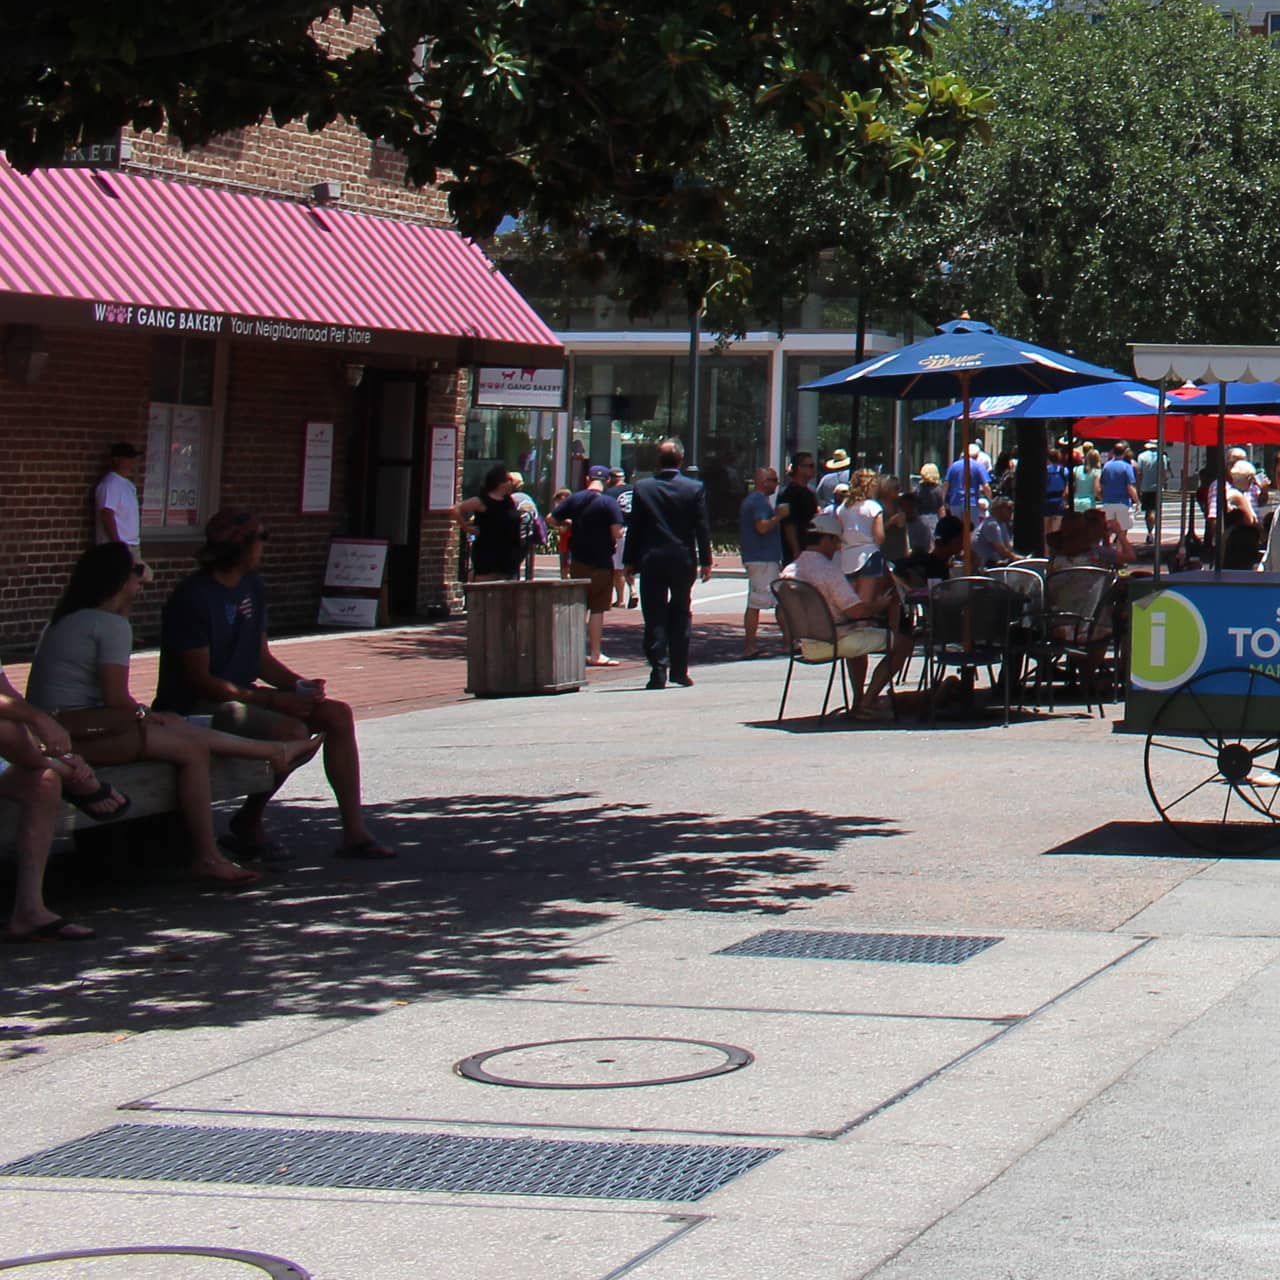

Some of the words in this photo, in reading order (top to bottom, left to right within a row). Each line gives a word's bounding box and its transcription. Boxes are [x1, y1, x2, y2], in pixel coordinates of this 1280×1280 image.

[137, 308, 175, 329] GANG
[179, 313, 224, 333] BAKERY
[230, 316, 253, 335] Your
[255, 320, 329, 343] Neighborhood
[330, 327, 346, 343] Pet
[346, 328, 371, 344] Store
